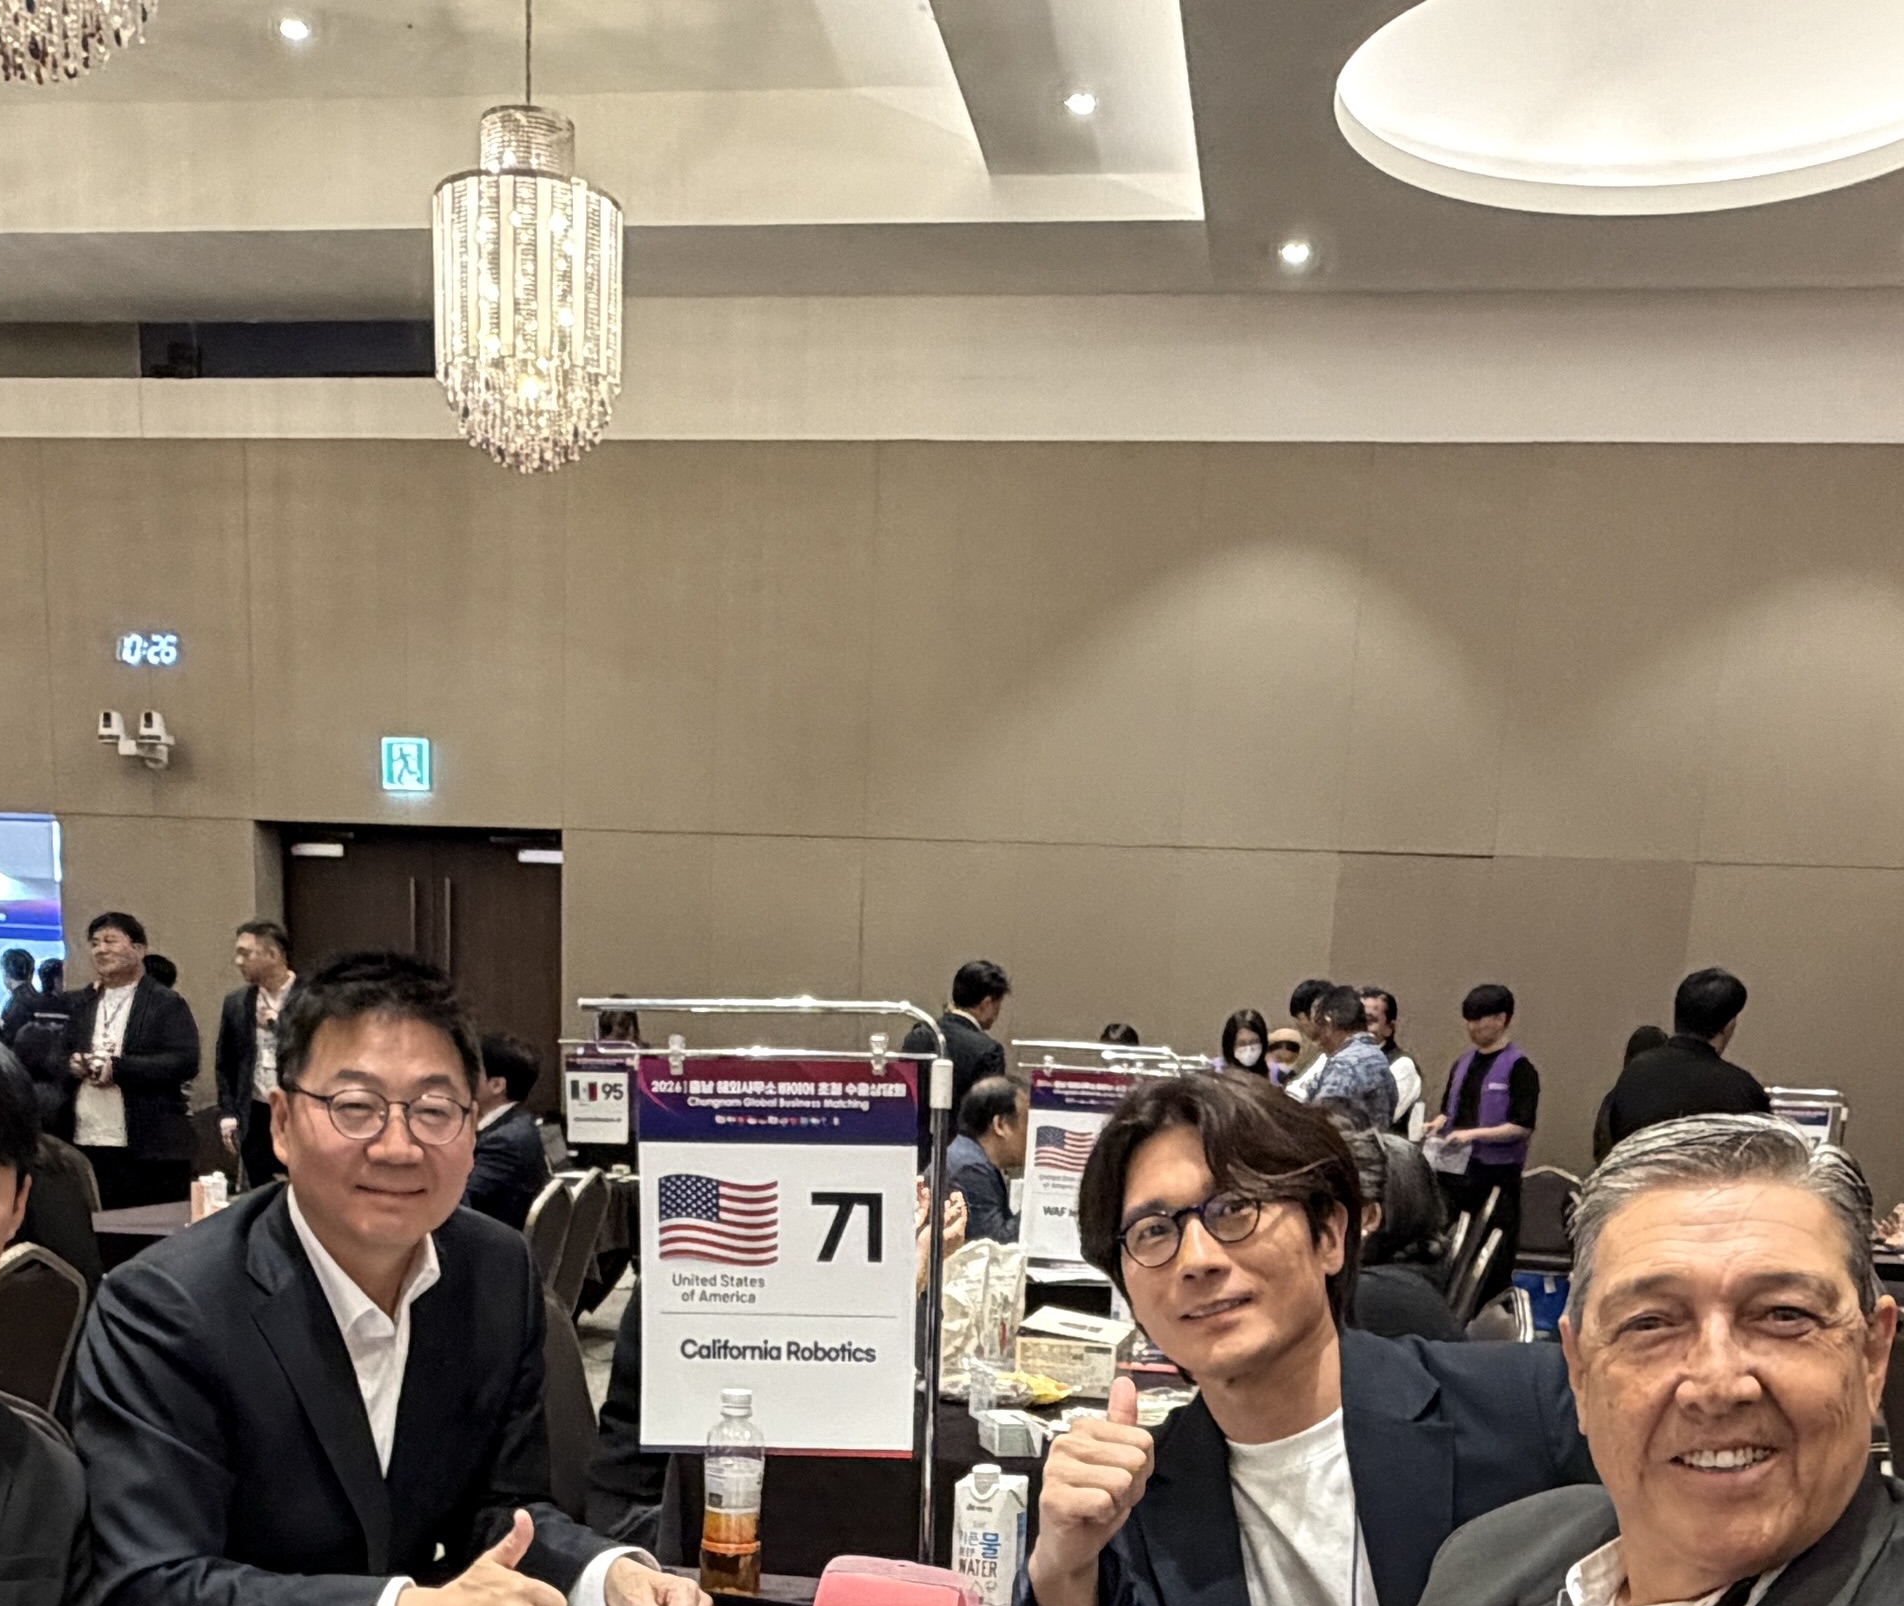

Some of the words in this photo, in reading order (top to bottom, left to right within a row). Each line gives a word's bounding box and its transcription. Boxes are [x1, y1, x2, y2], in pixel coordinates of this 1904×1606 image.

[601, 1083, 624, 1101] 95
[651, 1081, 682, 1093] 2026
[811, 1192, 883, 1263] 71
[672, 1273, 717, 1287] United
[720, 1274, 765, 1288] States
[681, 1289, 694, 1302] of
[699, 1290, 756, 1304] America
[680, 1338, 782, 1360] California
[787, 1340, 876, 1363] Robotics
[959, 1559, 997, 1578] WATER
